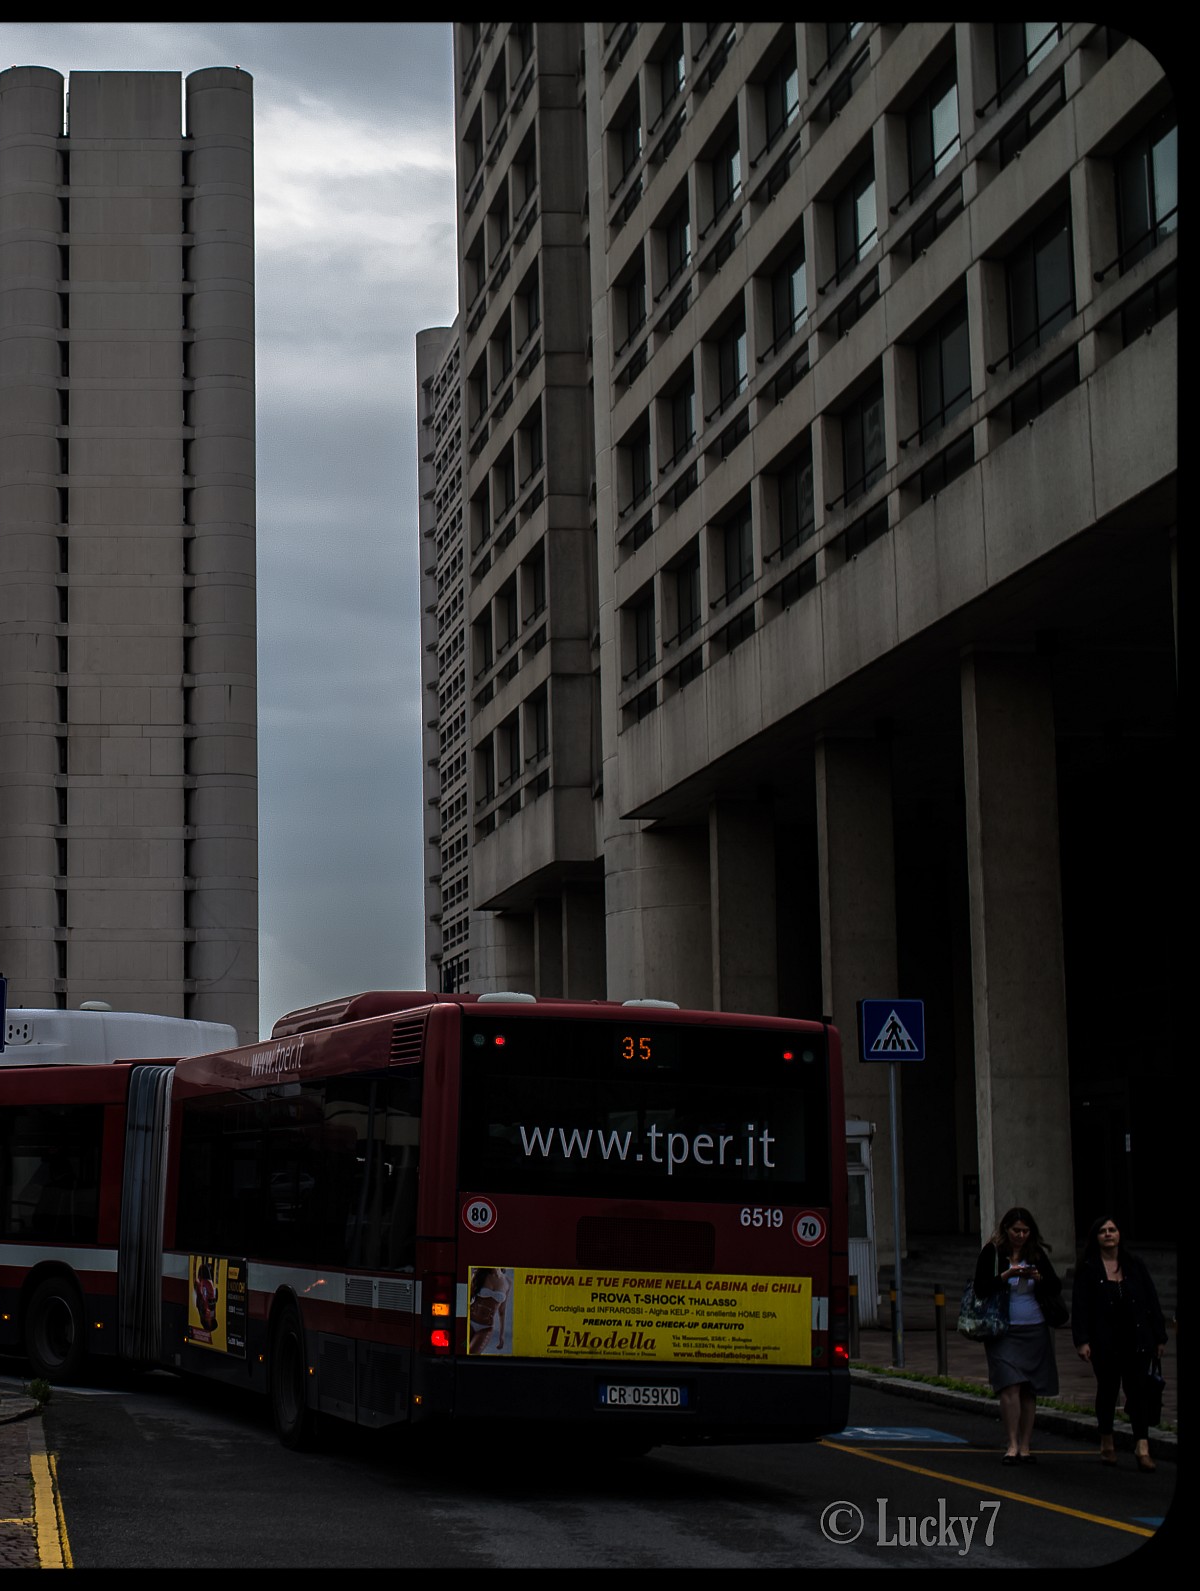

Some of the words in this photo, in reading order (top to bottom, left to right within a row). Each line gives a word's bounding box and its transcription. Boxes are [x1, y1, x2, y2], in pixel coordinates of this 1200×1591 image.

[621, 1036, 653, 1061] 35
[251, 1034, 304, 1083] www.tper.it
[519, 1122, 776, 1176] www.tper.it
[471, 1206, 488, 1223] 80
[740, 1207, 784, 1229] 6519
[801, 1222, 818, 1238] 70
[525, 1274, 575, 1286] RITROVA
[578, 1276, 593, 1287] LE
[597, 1277, 620, 1288] TUE
[622, 1278, 662, 1289] FORME
[665, 1279, 702, 1291] NELLA
[705, 1281, 748, 1292] CABINA
[751, 1283, 768, 1293] dei
[771, 1283, 802, 1294] CHILI
[591, 1292, 631, 1304] PROVA
[634, 1294, 686, 1305] T-SHOCK
[688, 1297, 737, 1307] THALASSO
[549, 1304, 585, 1314] Conchiglia
[586, 1305, 596, 1313] ad
[597, 1306, 644, 1315] INFRAROSSI
[670, 1308, 690, 1317] KELP
[695, 1309, 705, 1317] Kit
[738, 1311, 760, 1319] HOME
[762, 1311, 777, 1320] SPA
[582, 1318, 622, 1327] PRENOTA
[624, 1319, 633, 1327] IL
[636, 1320, 653, 1328] TUO
[656, 1321, 699, 1329] CHECK-UP
[701, 1322, 744, 1331] GRATUITO
[546, 1325, 656, 1350] TiModella
[609, 1387, 627, 1404] CR
[632, 1387, 679, 1405] 059KD
